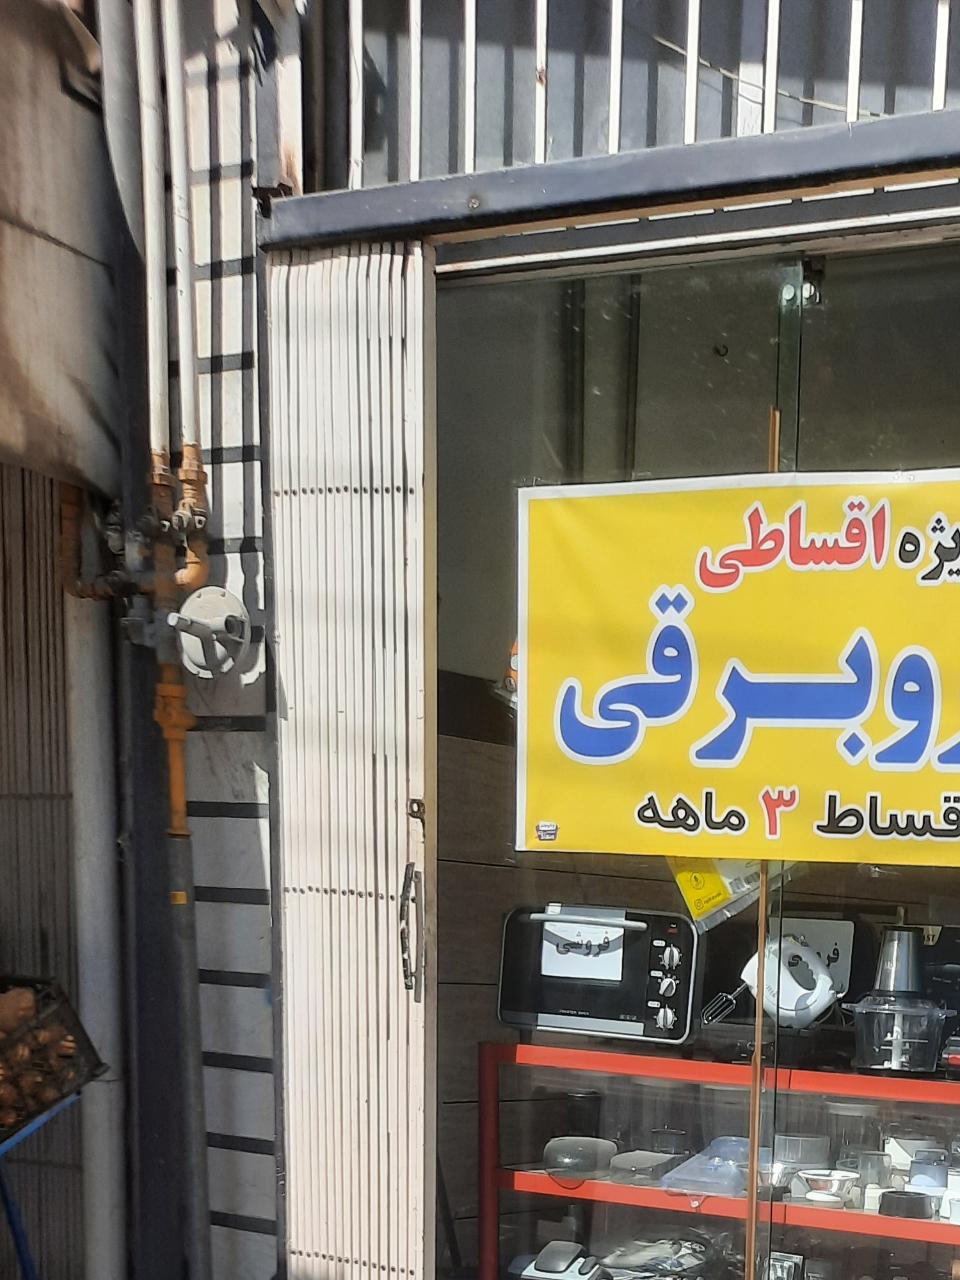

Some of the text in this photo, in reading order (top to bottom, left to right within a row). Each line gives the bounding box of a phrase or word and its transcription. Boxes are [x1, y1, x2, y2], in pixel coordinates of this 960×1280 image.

[699, 498, 886, 588] اقساطی
[637, 792, 746, 832] ماهه
[763, 792, 797, 836] ۳
